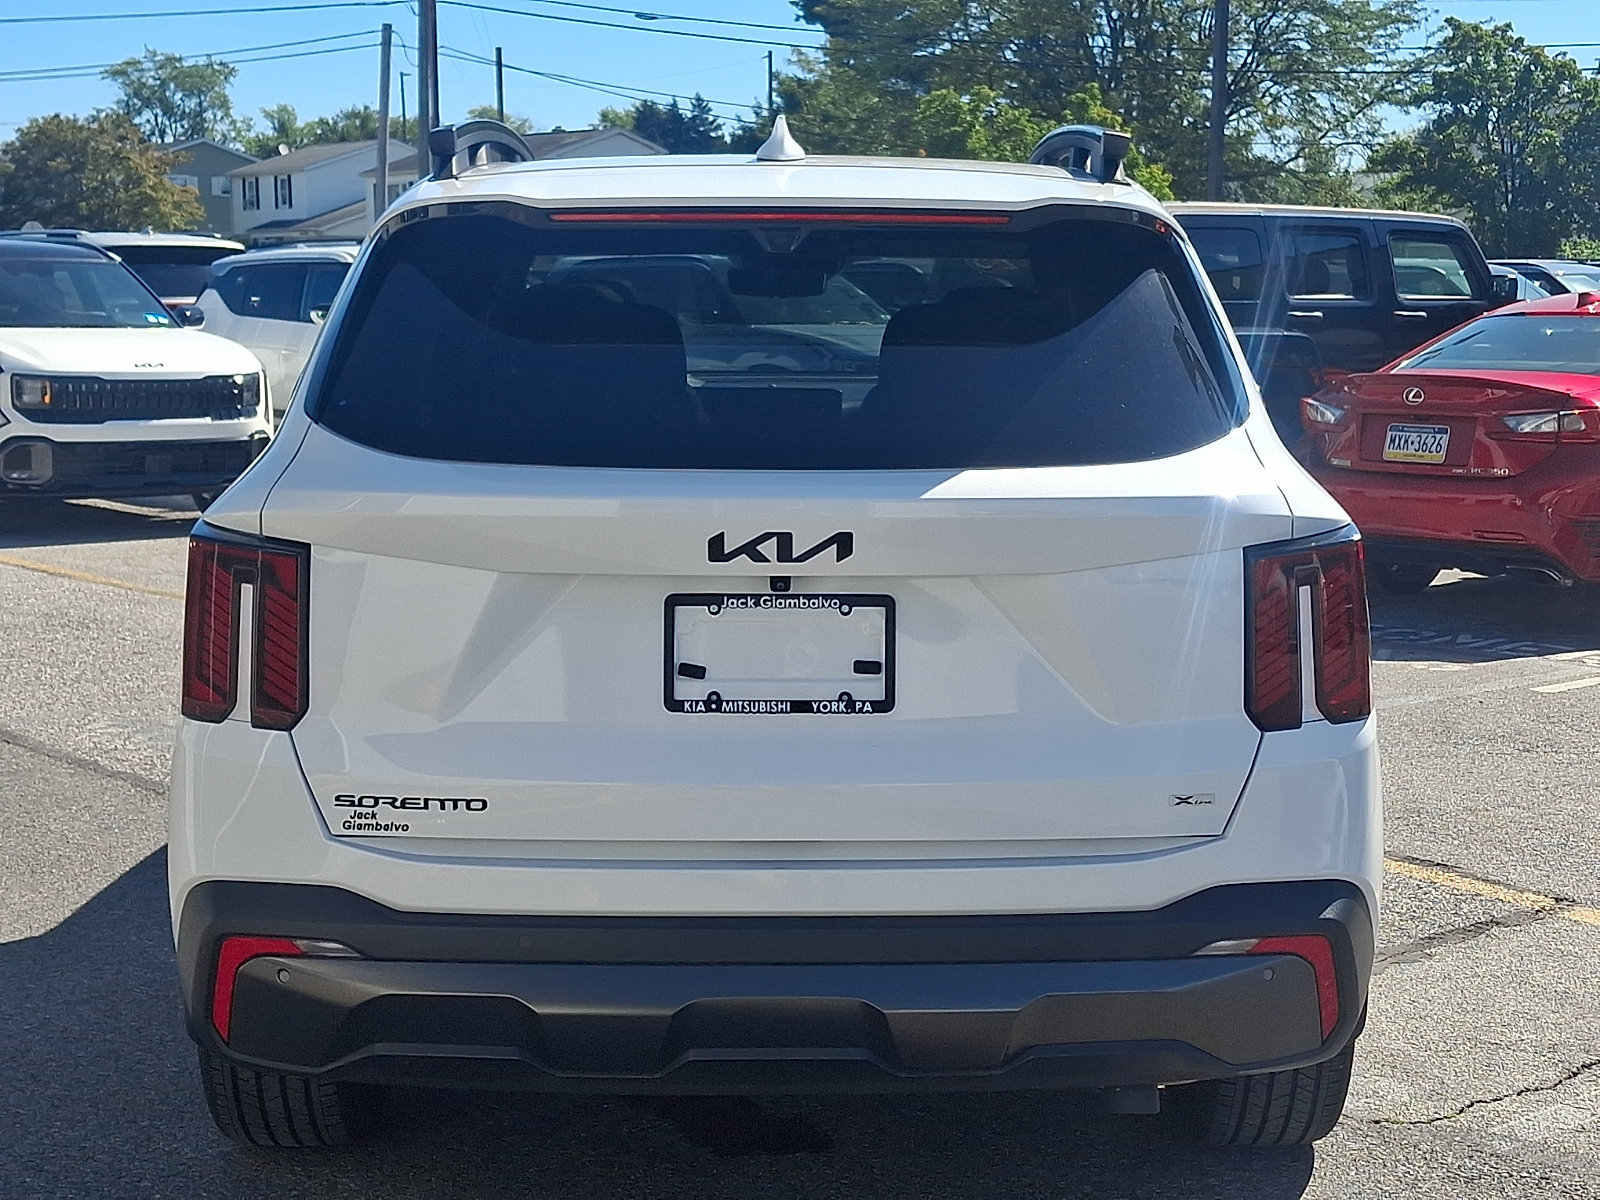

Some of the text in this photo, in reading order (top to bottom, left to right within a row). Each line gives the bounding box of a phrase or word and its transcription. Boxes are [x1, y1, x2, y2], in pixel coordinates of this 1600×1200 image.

[708, 531, 854, 563] KIA
[721, 596, 840, 609] Jack Giambalvo
[683, 701, 791, 713] KIA MITSUBISHI
[811, 701, 873, 713] YORK, PA
[334, 795, 488, 811] SORENTO
[350, 810, 378, 820] Jack
[342, 820, 410, 832] Giambalvo
